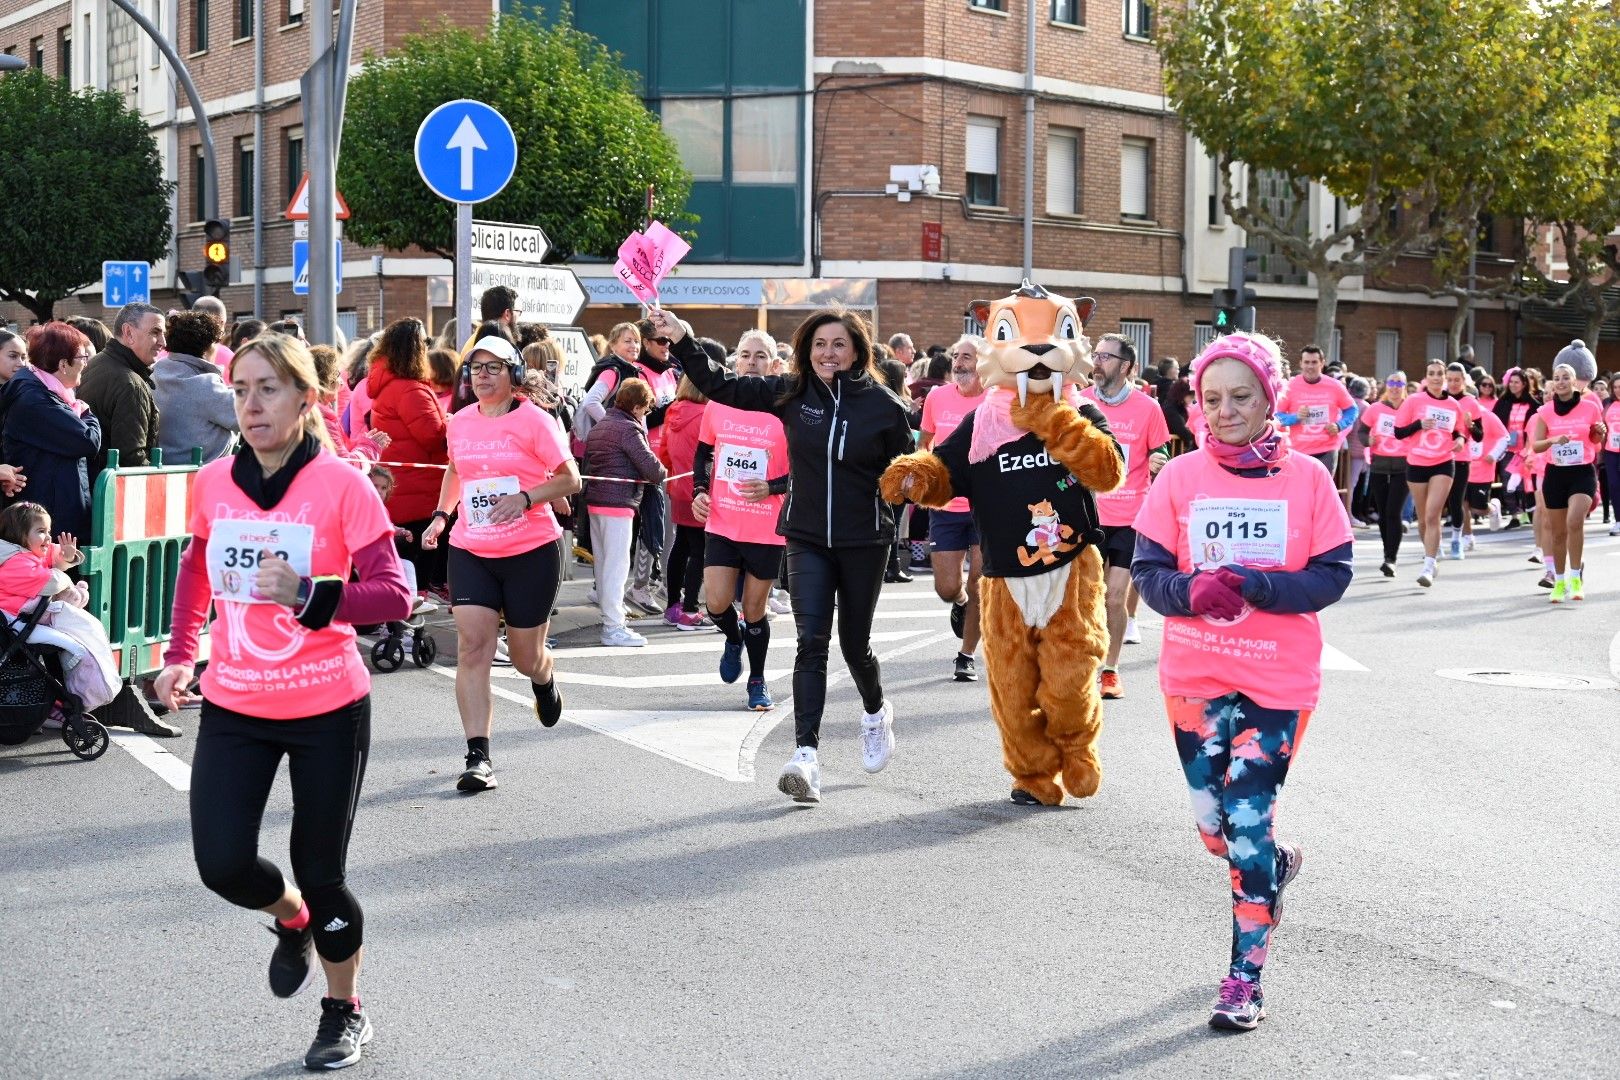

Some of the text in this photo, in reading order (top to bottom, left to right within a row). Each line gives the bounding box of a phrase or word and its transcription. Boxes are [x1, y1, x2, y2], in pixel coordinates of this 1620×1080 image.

[509, 231, 540, 254] local
[683, 286, 689, 295] Y
[692, 286, 750, 296] EXPLOSIVOS
[564, 360, 579, 376] del
[1431, 413, 1450, 423] 1235
[1557, 449, 1578, 457] 1234
[726, 456, 758, 471] 5464
[471, 492, 508, 509] 55
[1205, 520, 1268, 539] 0115
[1167, 621, 1277, 651] CARRERA DE LA MUJER
[216, 655, 345, 681] CARRERA DE LA MUJER
